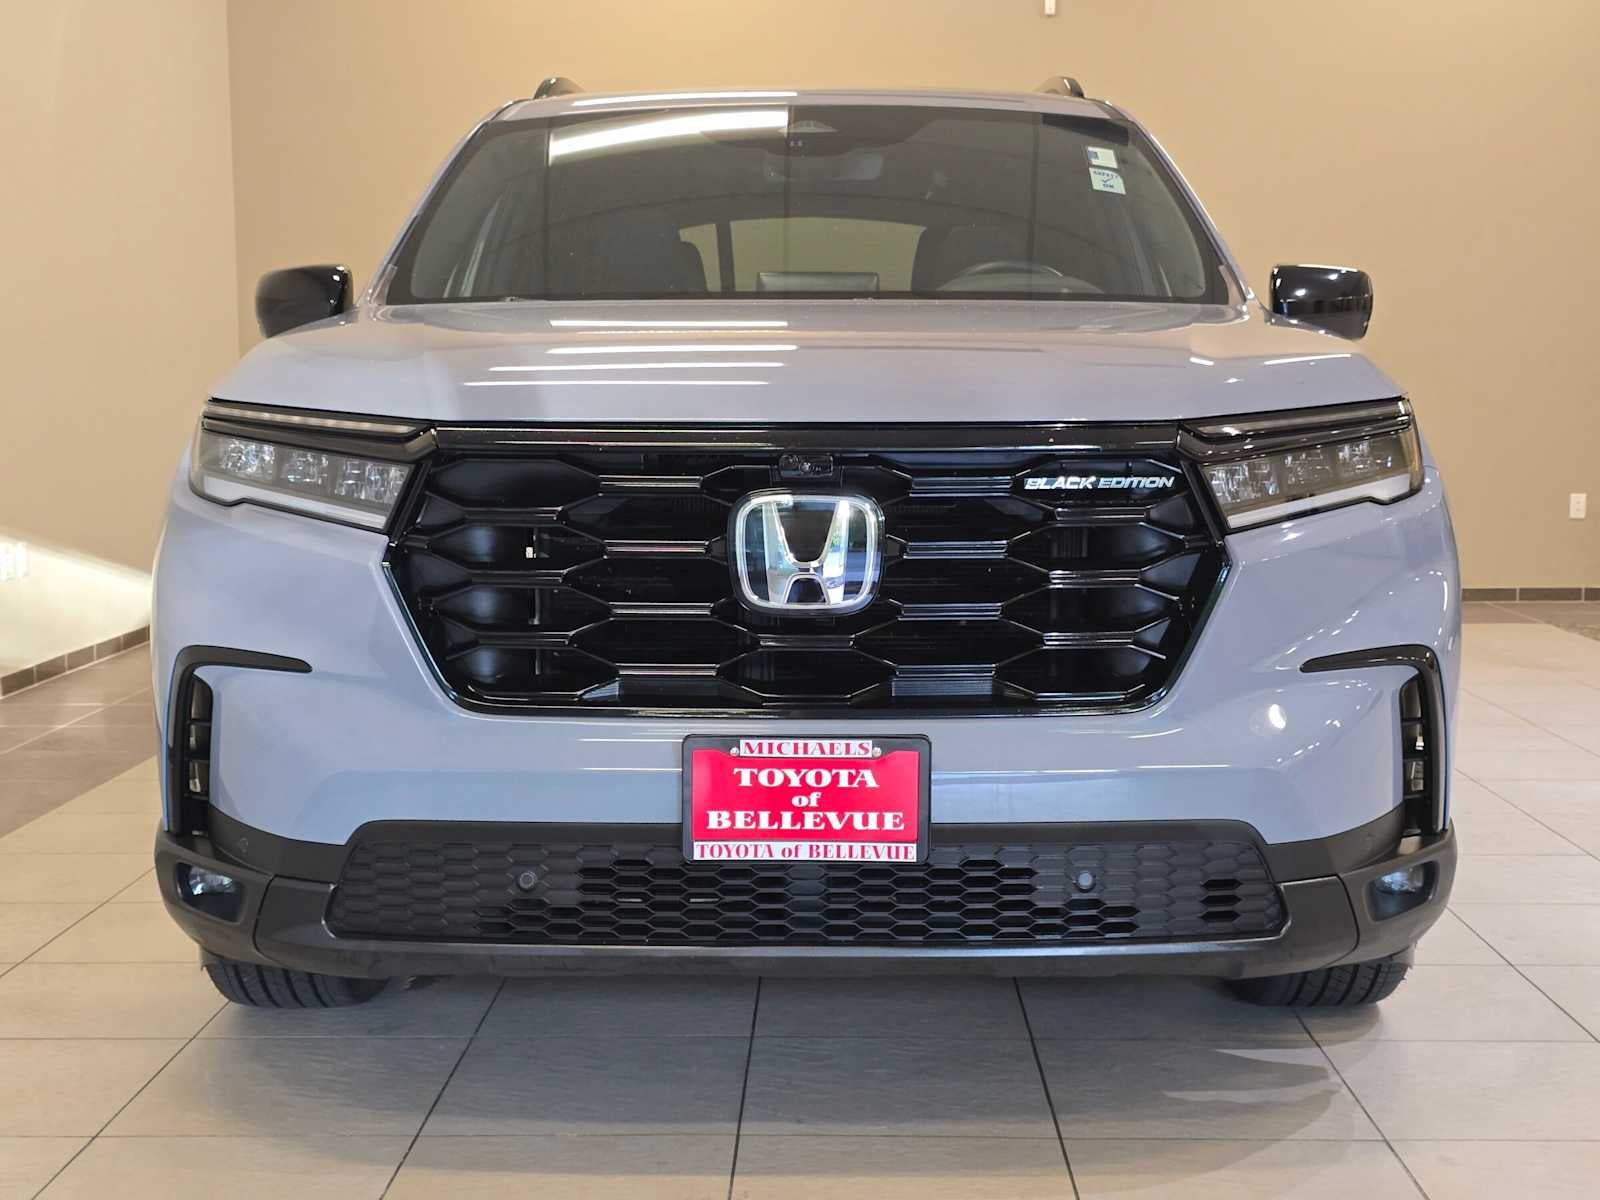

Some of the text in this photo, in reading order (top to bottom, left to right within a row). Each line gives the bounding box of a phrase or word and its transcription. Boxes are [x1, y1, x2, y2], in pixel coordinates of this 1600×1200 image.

[1024, 475, 1175, 490] BLACK EDITION
[743, 741, 871, 756] MICHAELS
[733, 767, 880, 788] TOYOTA
[791, 791, 822, 808] of
[706, 810, 905, 831] BELLEVUE
[696, 843, 915, 860] TOYOTA of BELLEVUE
